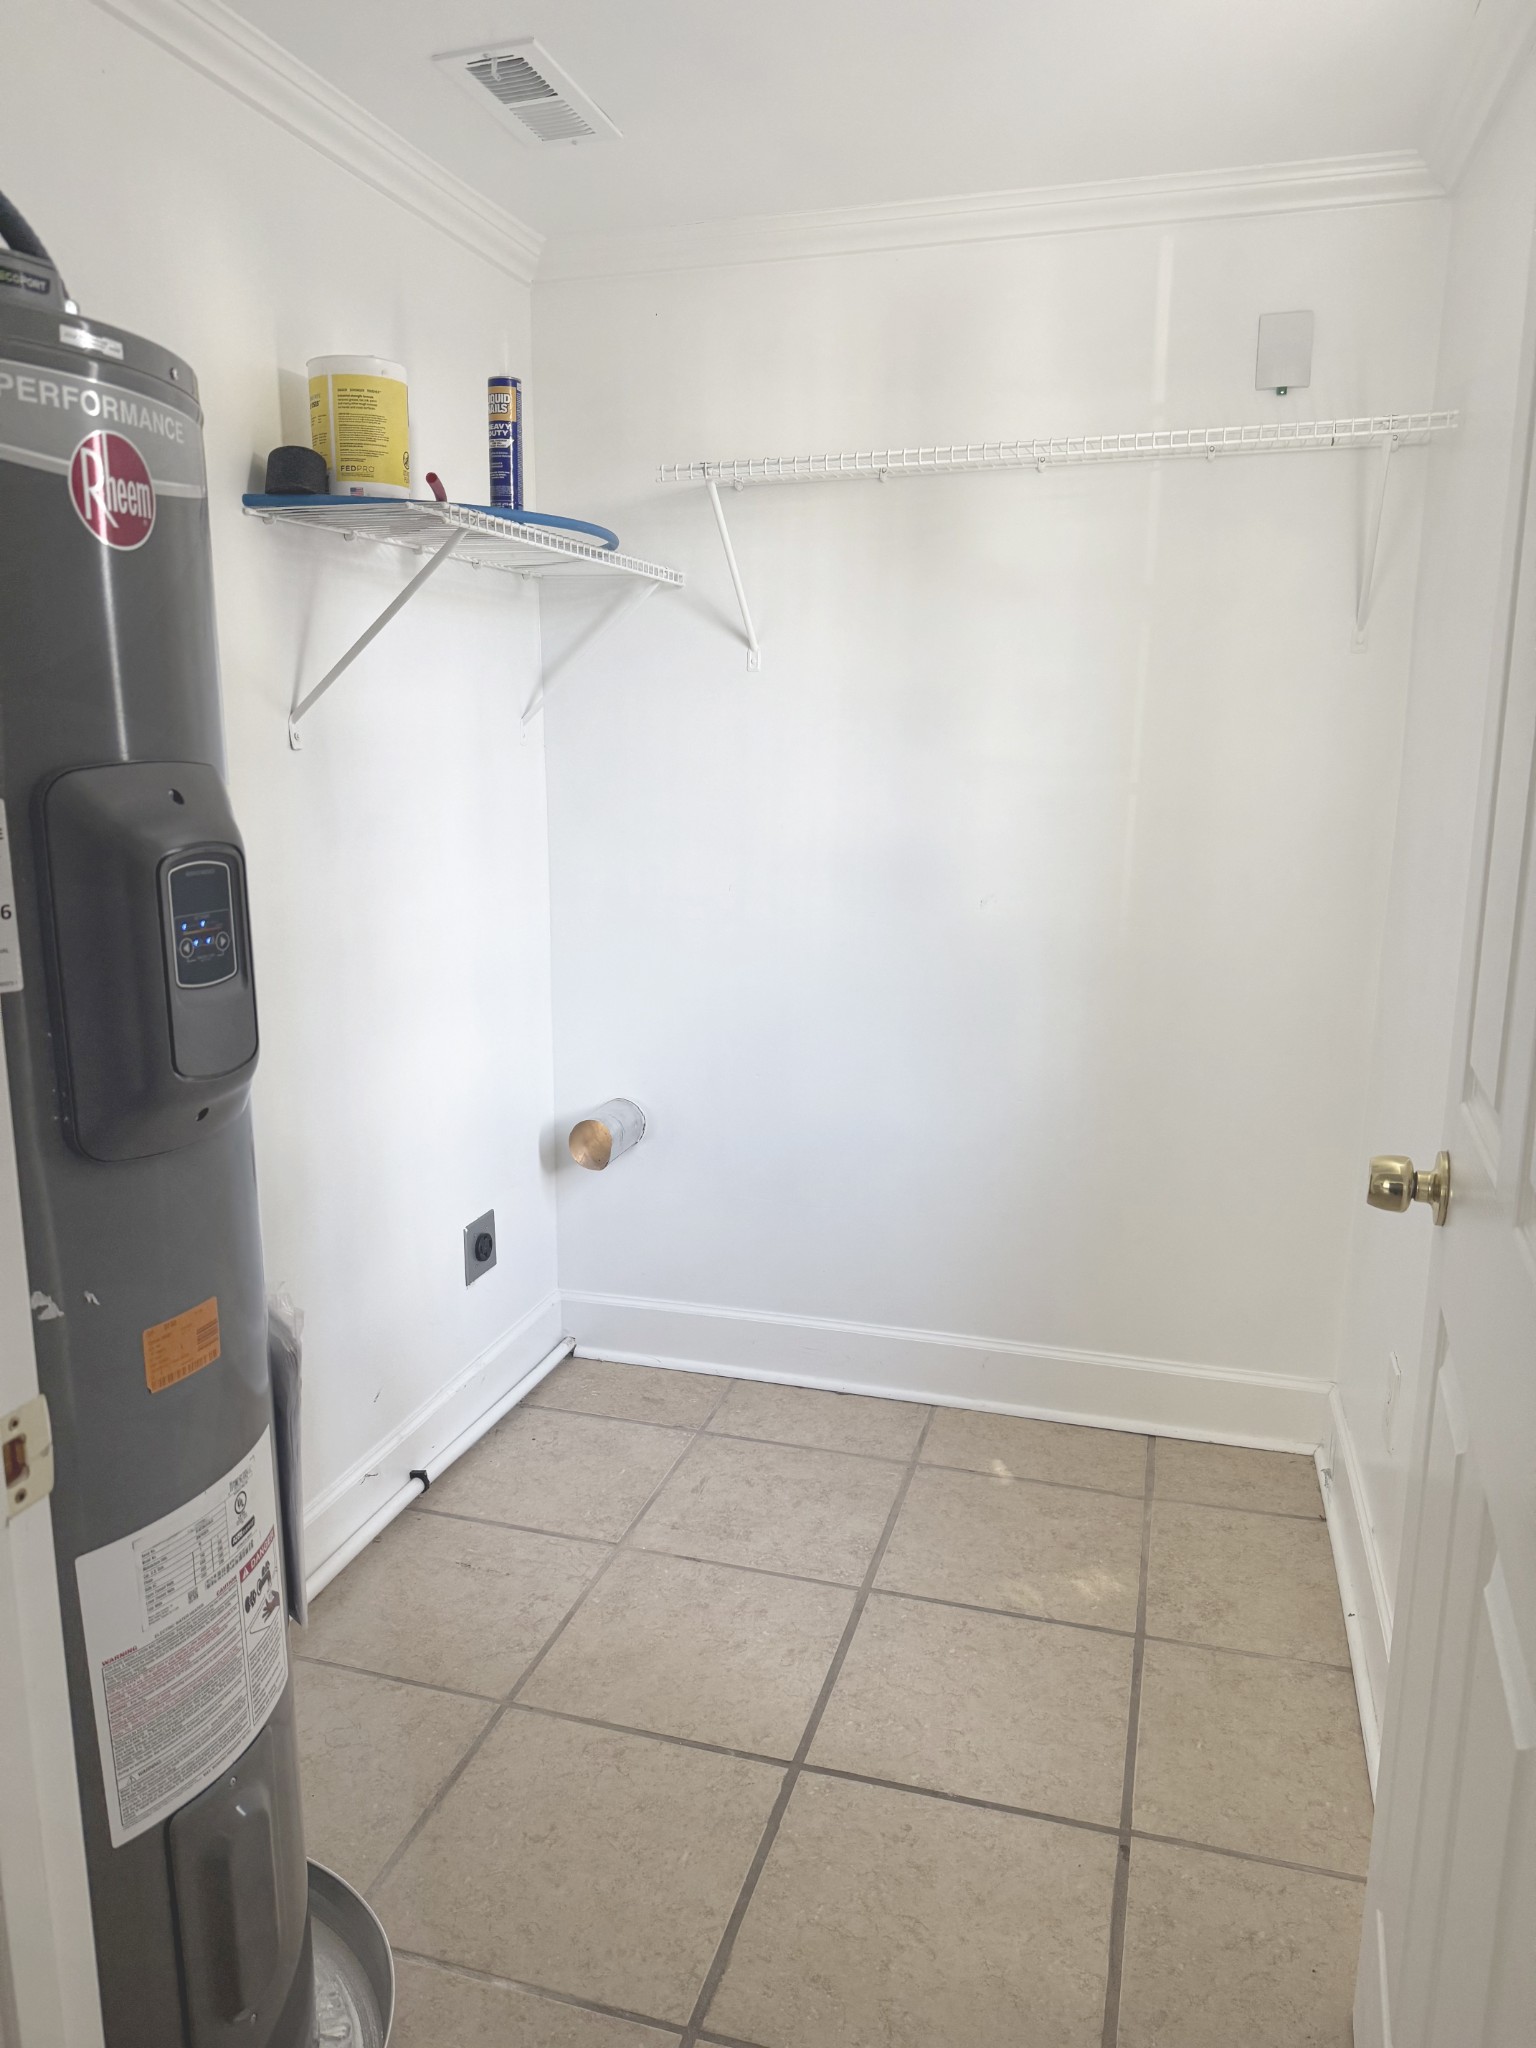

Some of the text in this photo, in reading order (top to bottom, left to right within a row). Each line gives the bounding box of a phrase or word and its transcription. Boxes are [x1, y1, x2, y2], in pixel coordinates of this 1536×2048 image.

[0, 371, 185, 444] PERFORMANCE
[488, 393, 510, 404] IQUID
[489, 403, 508, 414] AILS
[80, 431, 153, 528] Rheem
[340, 465, 375, 473] FEDPRO
[249, 1527, 275, 1568] DANGER
[101, 1645, 138, 1667] WARNING
